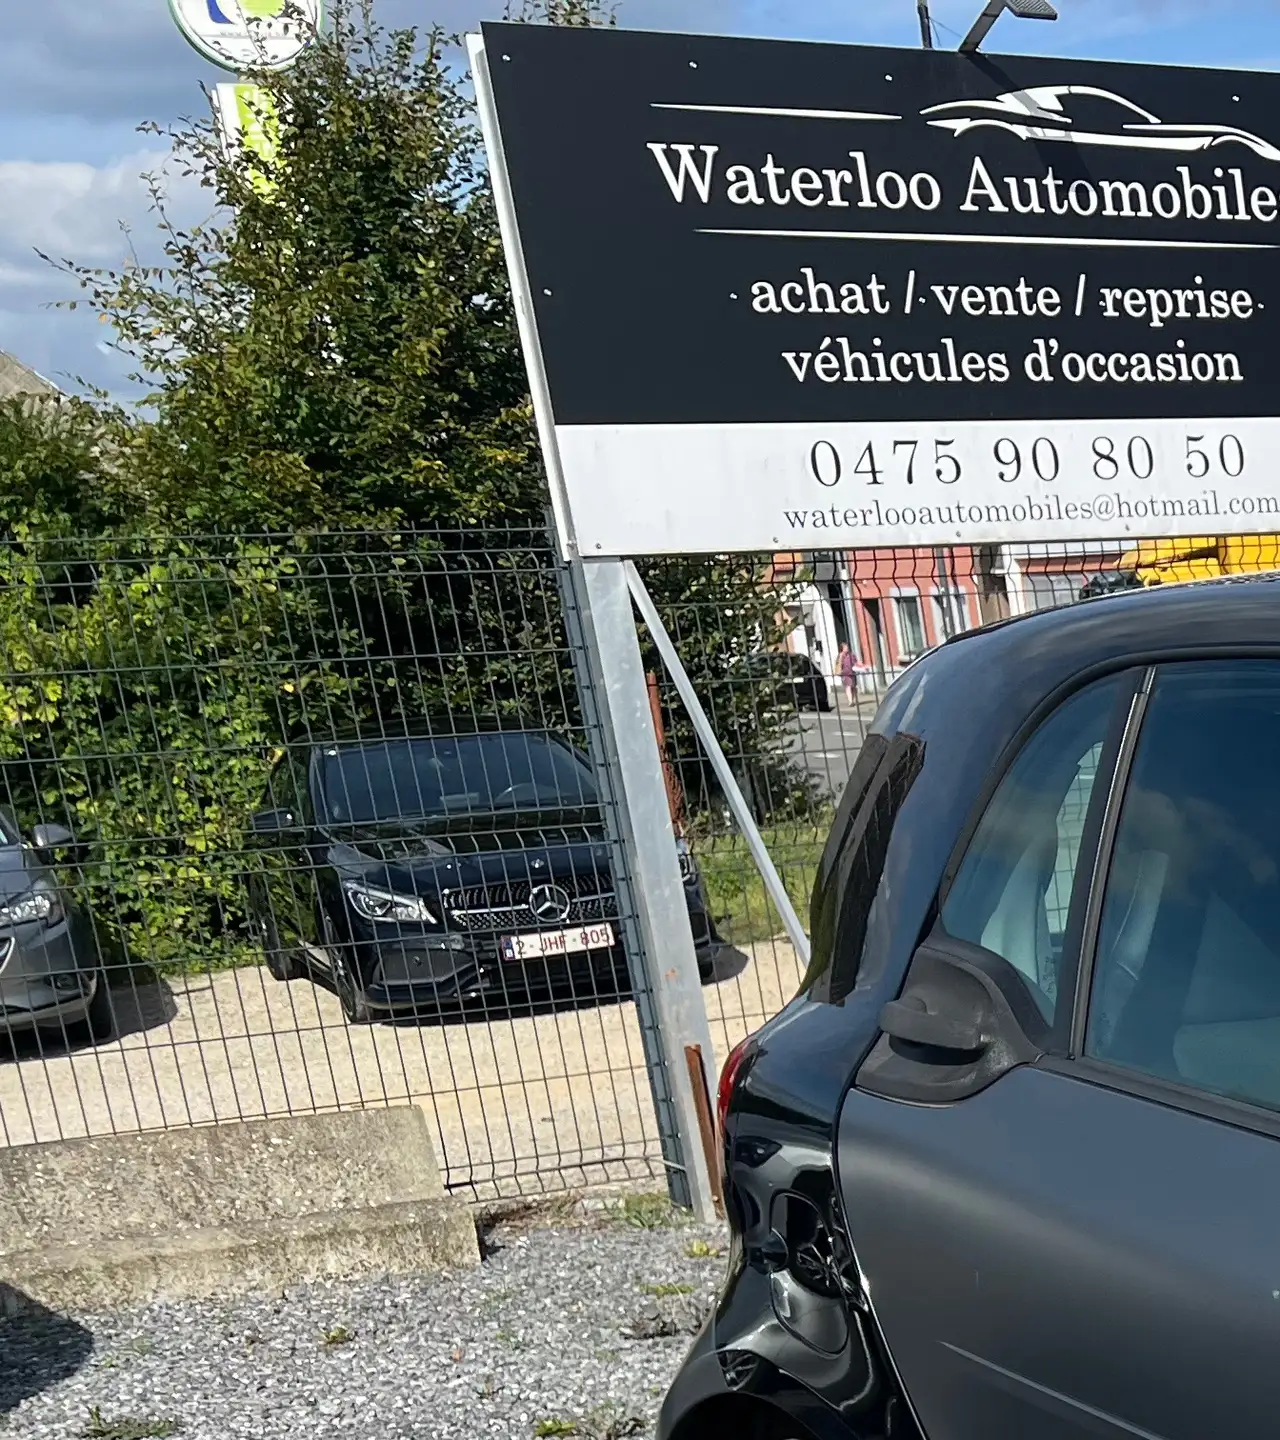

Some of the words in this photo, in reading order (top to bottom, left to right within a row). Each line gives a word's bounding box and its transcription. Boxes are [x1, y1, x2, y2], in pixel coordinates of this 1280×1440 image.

[646, 143, 941, 211] Waterloo
[751, 267, 890, 314] achat
[930, 276, 1062, 317] vente
[1099, 275, 1254, 328] reprise
[781, 336, 1010, 383] véhicules
[810, 439, 962, 487] 0475
[993, 437, 1060, 482] 90
[1092, 436, 1155, 480] 80
[1185, 434, 1245, 477] 50
[784, 490, 1280, 529] waterlooautomobiles@hotmail.com
